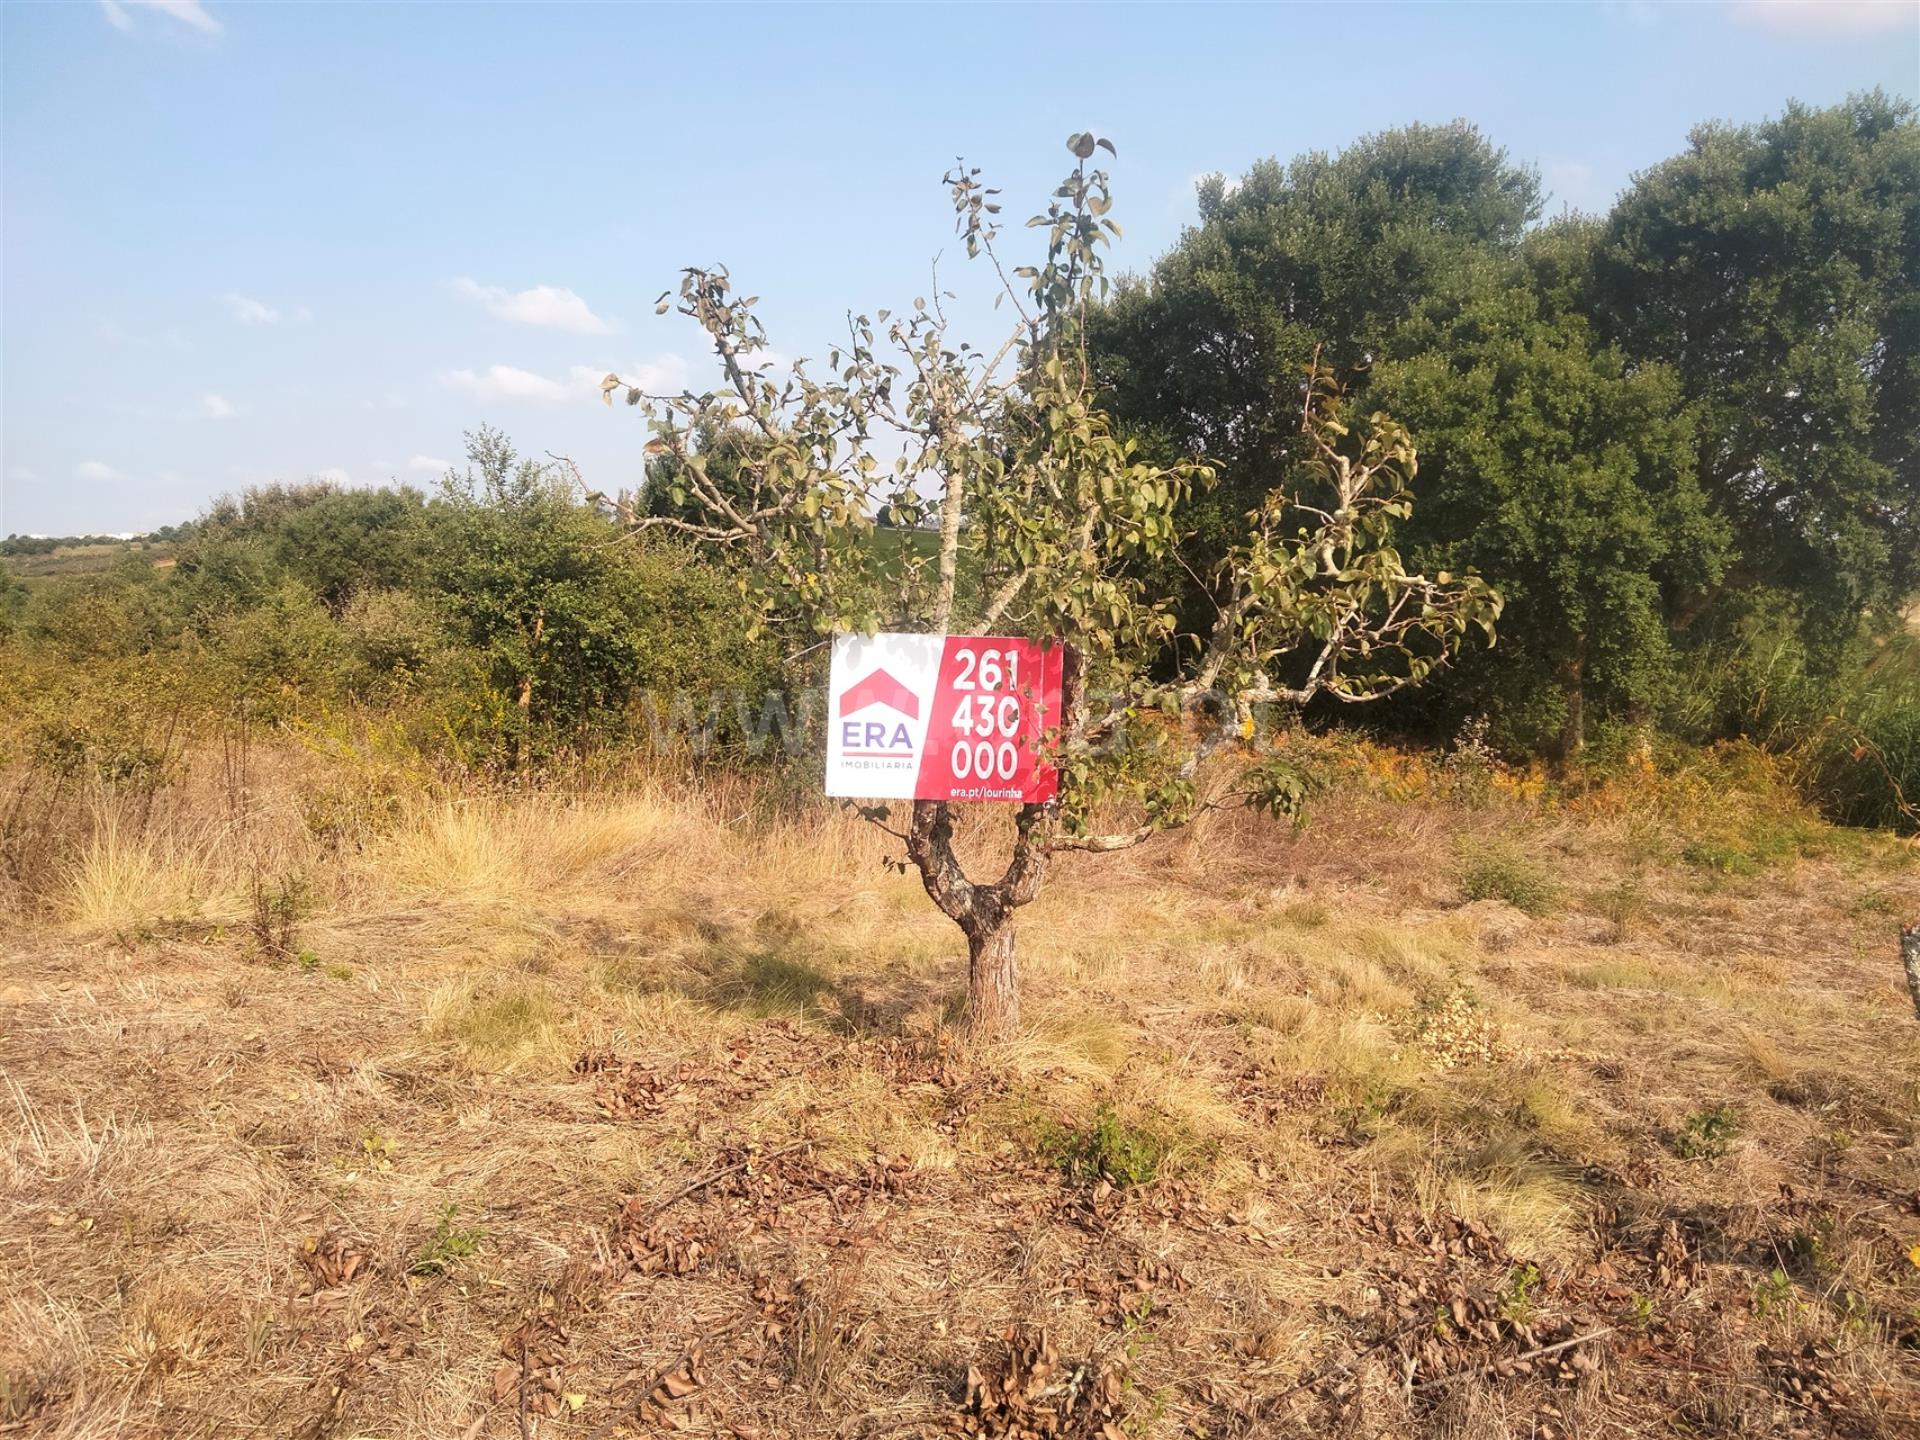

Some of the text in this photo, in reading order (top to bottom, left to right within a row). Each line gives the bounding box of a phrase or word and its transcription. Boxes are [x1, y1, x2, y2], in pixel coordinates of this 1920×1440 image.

[953, 649, 1019, 691] 261
[842, 722, 913, 748] ERA
[952, 695, 1020, 737] 430
[951, 741, 1018, 780] 000
[950, 786, 1023, 799] era.pt/lourinha
